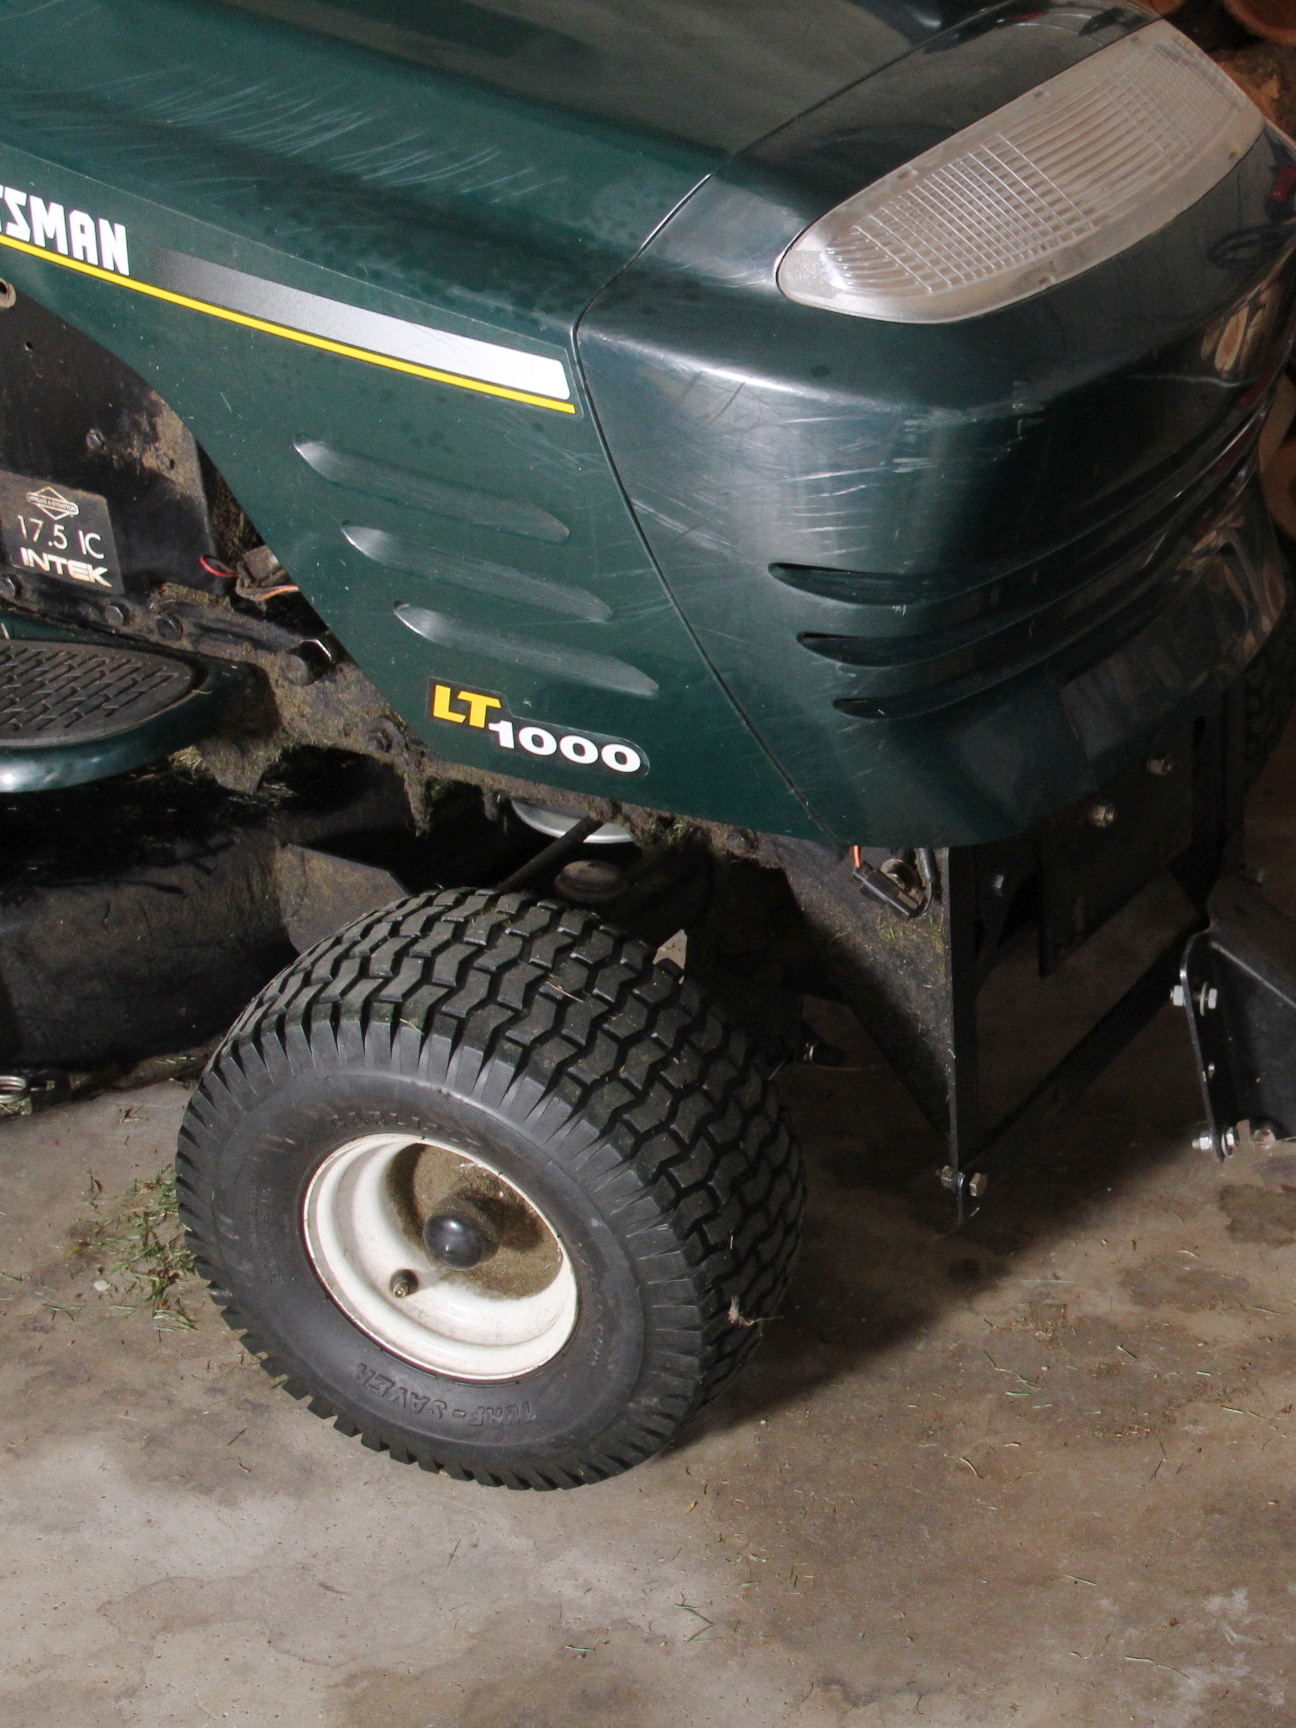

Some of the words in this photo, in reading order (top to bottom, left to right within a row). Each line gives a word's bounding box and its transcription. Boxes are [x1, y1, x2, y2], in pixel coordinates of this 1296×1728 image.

[0, 184, 130, 276] SMAN
[18, 514, 68, 550] 17.5
[78, 529, 104, 560] IC
[20, 547, 112, 588] INTEK
[433, 684, 501, 728] LT
[488, 720, 641, 773] 1000
